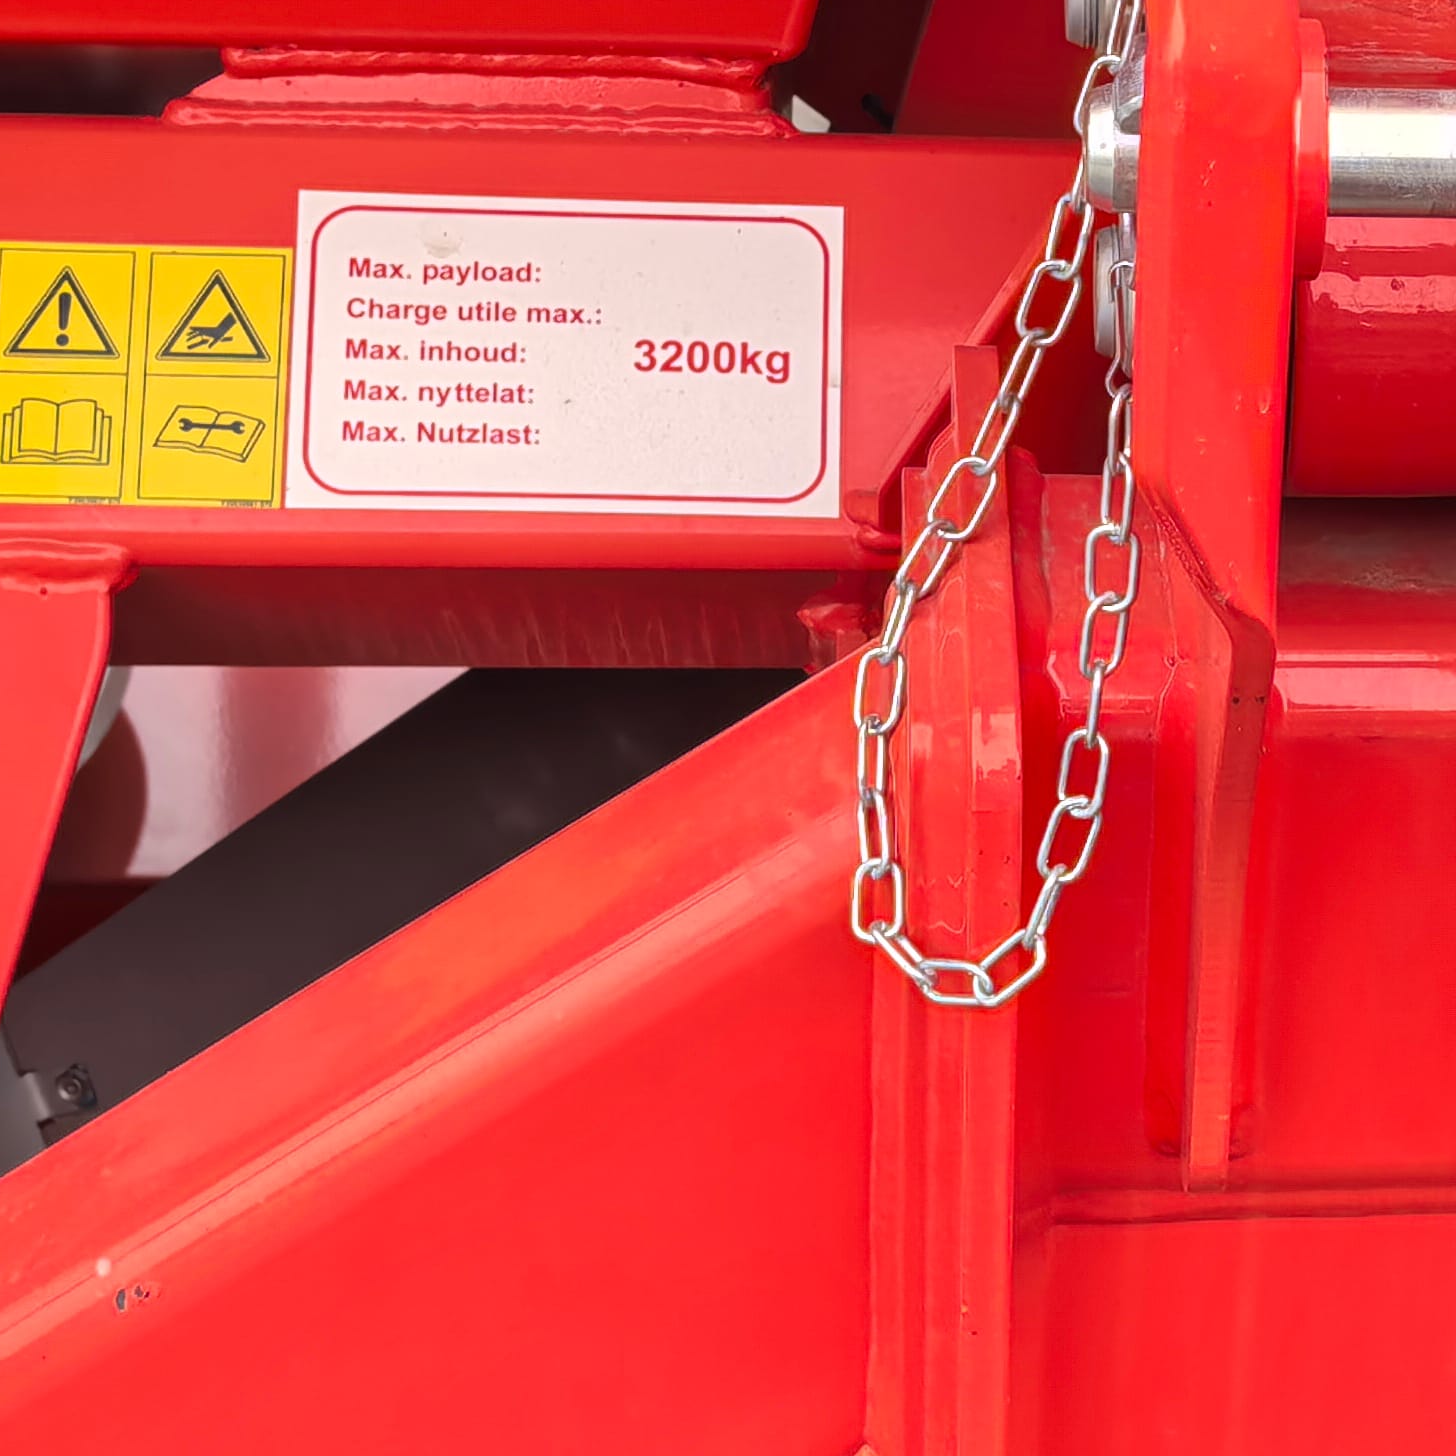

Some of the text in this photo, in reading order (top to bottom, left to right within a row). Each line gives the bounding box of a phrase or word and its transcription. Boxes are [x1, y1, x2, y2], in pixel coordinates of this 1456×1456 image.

[348, 257, 543, 288] Max. payload:
[346, 298, 603, 326] Charge utile max.:
[345, 338, 527, 365] Max. inhoud:
[634, 338, 792, 386] 3200kg
[344, 380, 536, 409] Max. nyttelat:
[342, 421, 541, 447] Max. Nutzlast:
